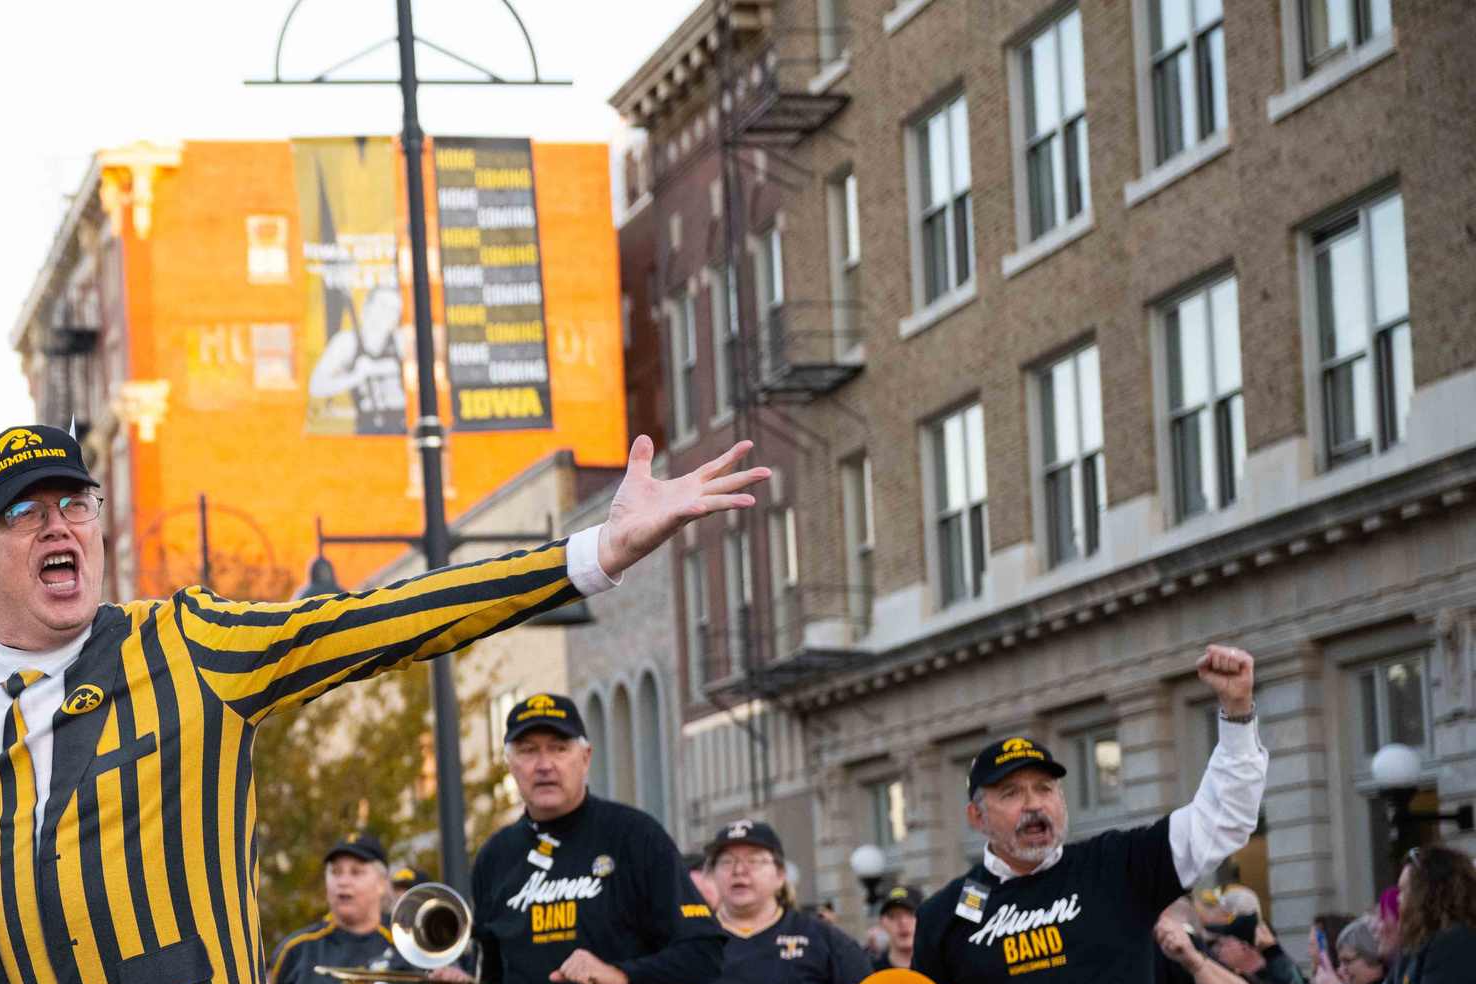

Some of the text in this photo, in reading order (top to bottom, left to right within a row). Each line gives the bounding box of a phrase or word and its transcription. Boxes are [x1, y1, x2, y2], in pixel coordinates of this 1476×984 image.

[435, 148, 475, 171] HOME
[474, 167, 531, 190] COMING
[438, 187, 477, 210] HOME
[477, 205, 535, 229] COMING
[441, 226, 481, 249] HOME
[480, 243, 538, 267] COMING
[443, 265, 484, 288] HOME
[483, 281, 542, 306] COMING
[446, 303, 486, 327] HOME
[485, 320, 544, 344] COMING
[449, 341, 489, 365] HOME
[488, 358, 547, 384] COMING
[459, 387, 543, 419] IOWA
[33, 448, 67, 459] BAND
[506, 870, 603, 913] Alumni
[531, 901, 577, 933] BAND
[968, 893, 1082, 946] Alumni
[1004, 926, 1063, 964] BAND
